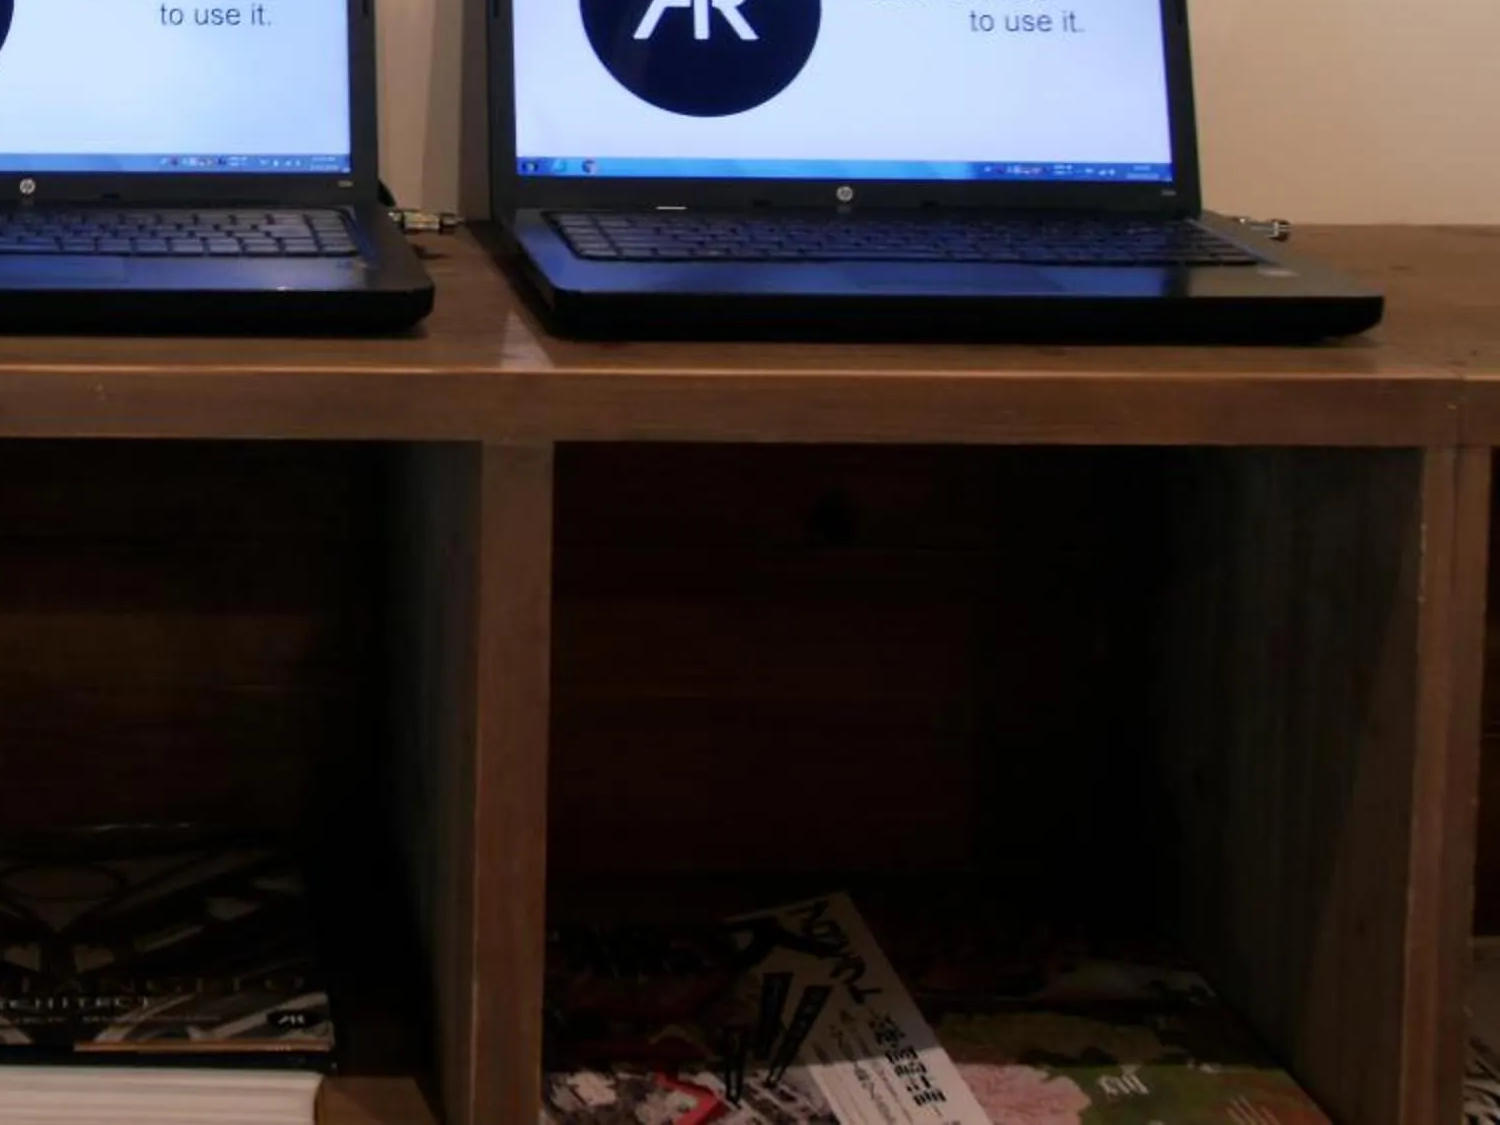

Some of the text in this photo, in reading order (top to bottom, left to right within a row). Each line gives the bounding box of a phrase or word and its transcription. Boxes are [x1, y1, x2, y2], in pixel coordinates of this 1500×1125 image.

[160, 3, 273, 26] to use it.
[970, 10, 1085, 33] to use it.
